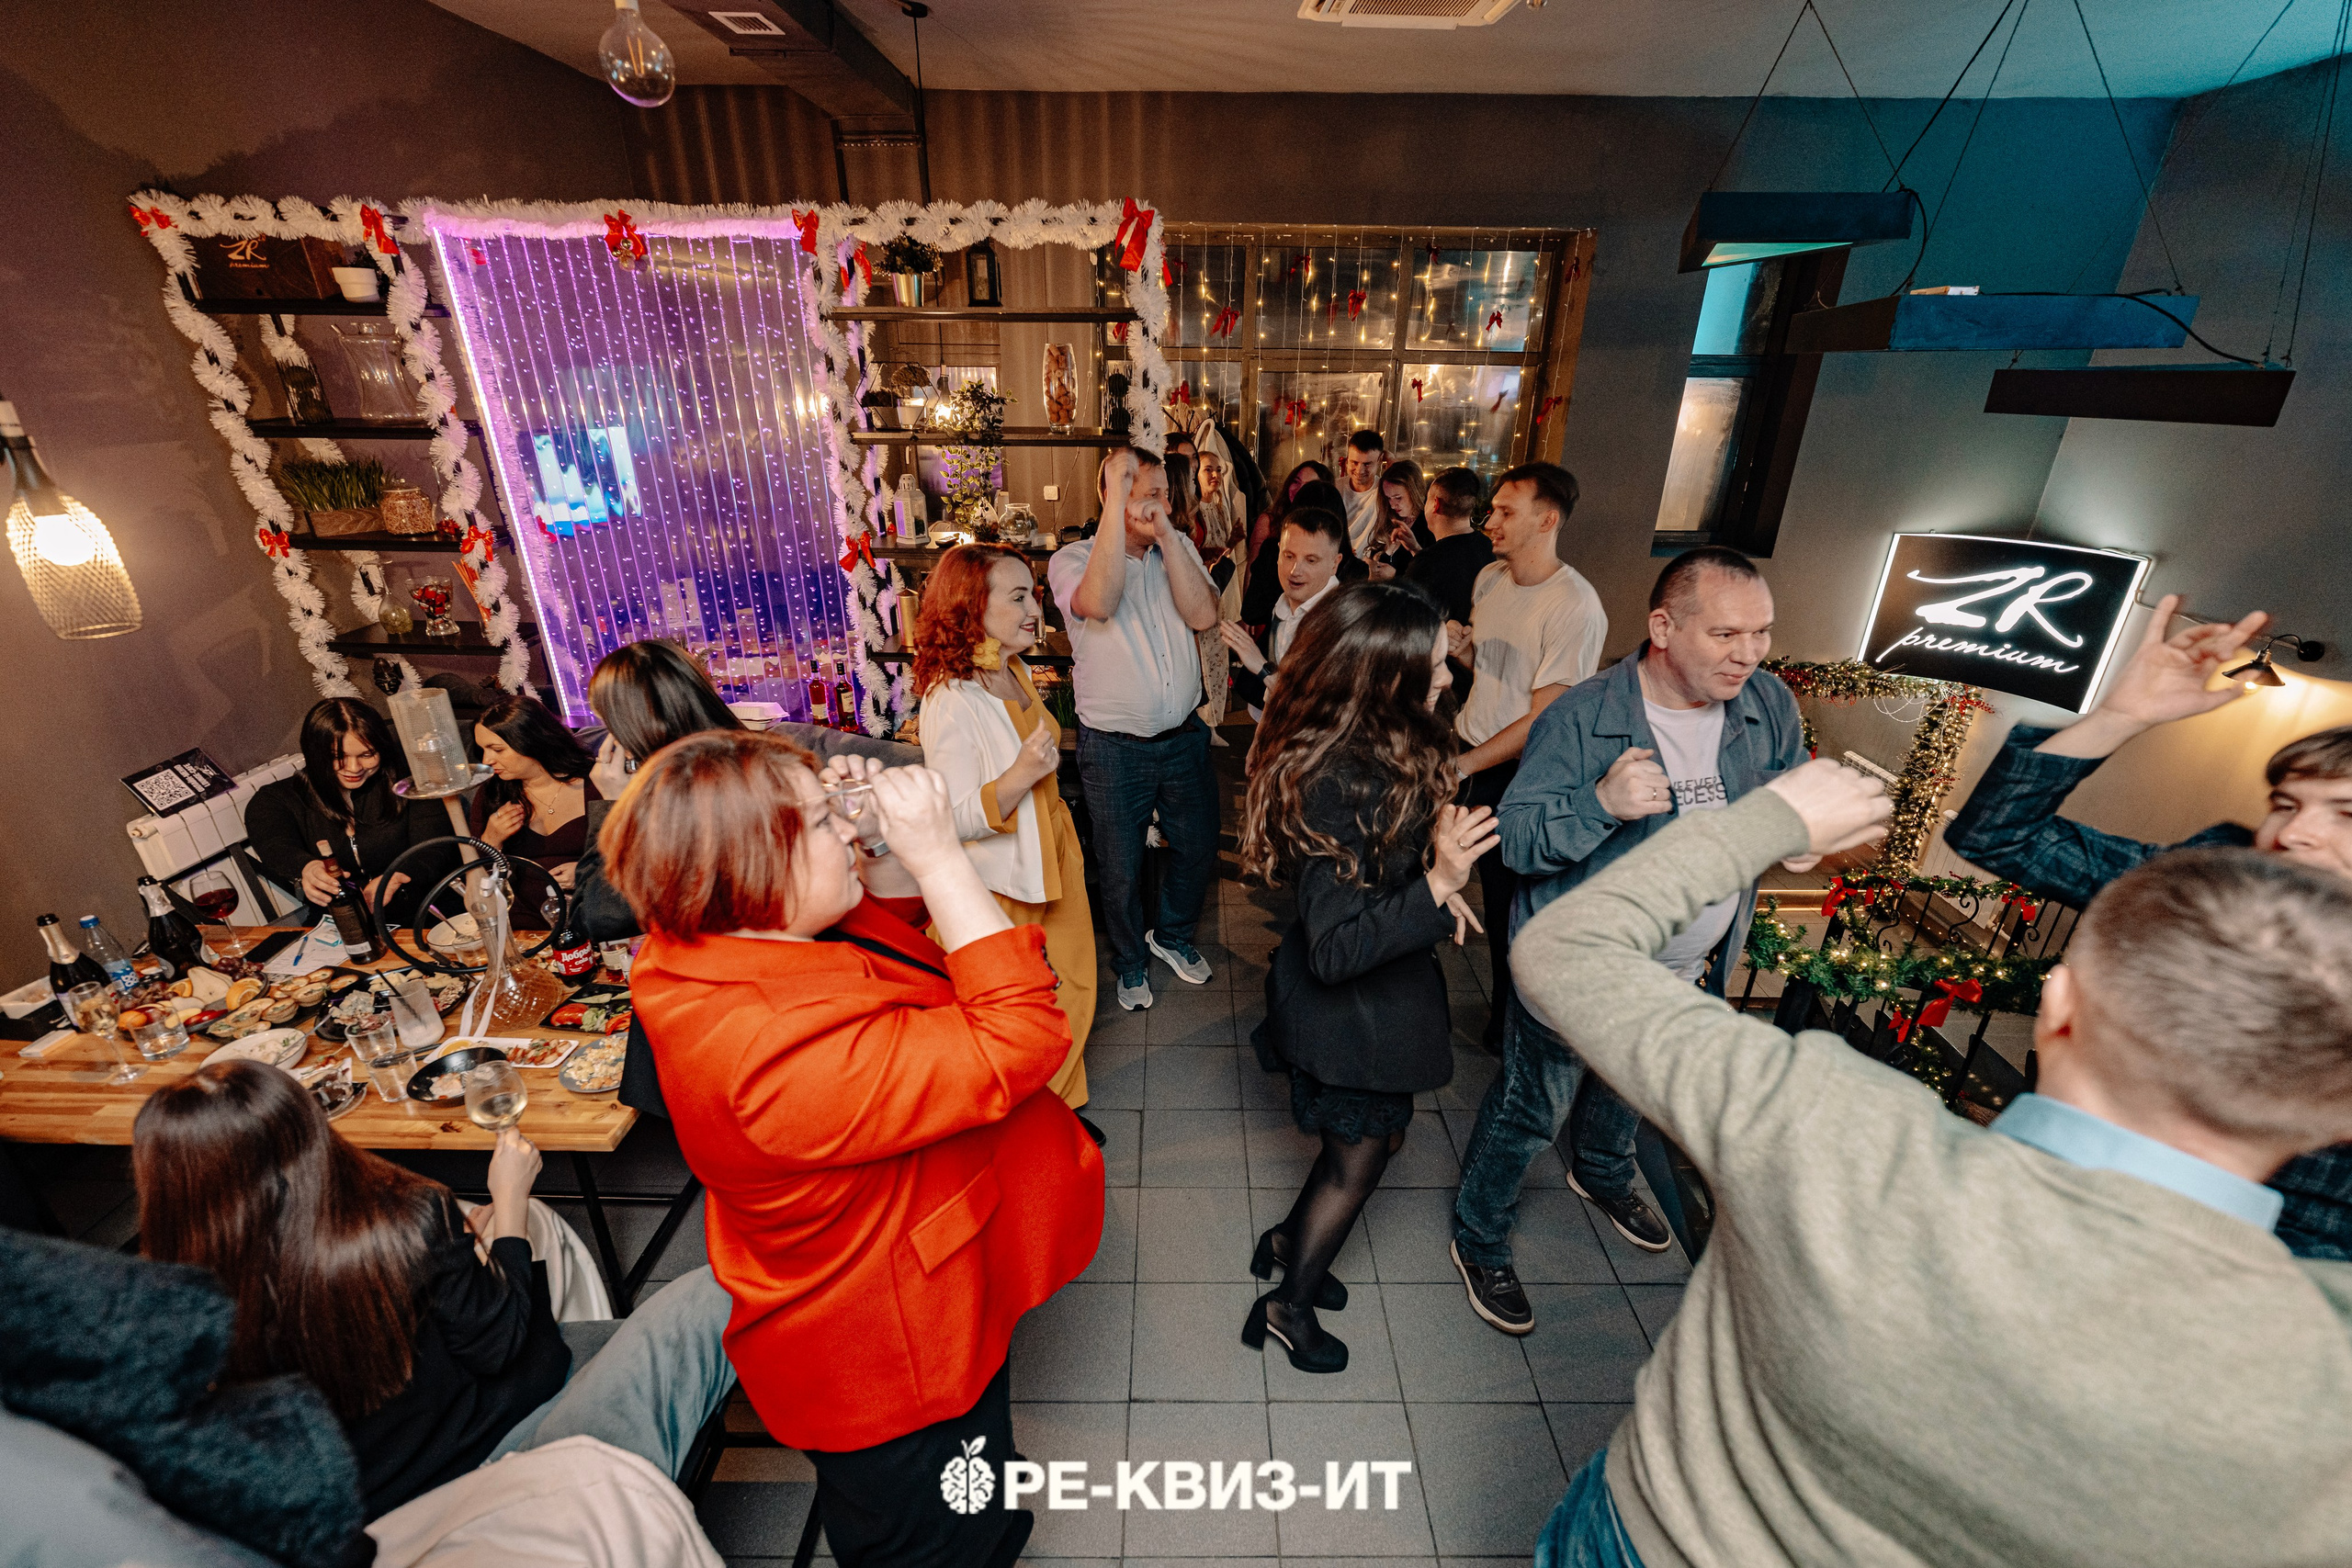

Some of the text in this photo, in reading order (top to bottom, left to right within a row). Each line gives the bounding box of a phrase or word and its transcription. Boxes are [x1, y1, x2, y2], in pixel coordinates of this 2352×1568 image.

[220, 239, 267, 261] ZR
[1906, 566, 2093, 649] ZR
[1875, 626, 2080, 673] premium
